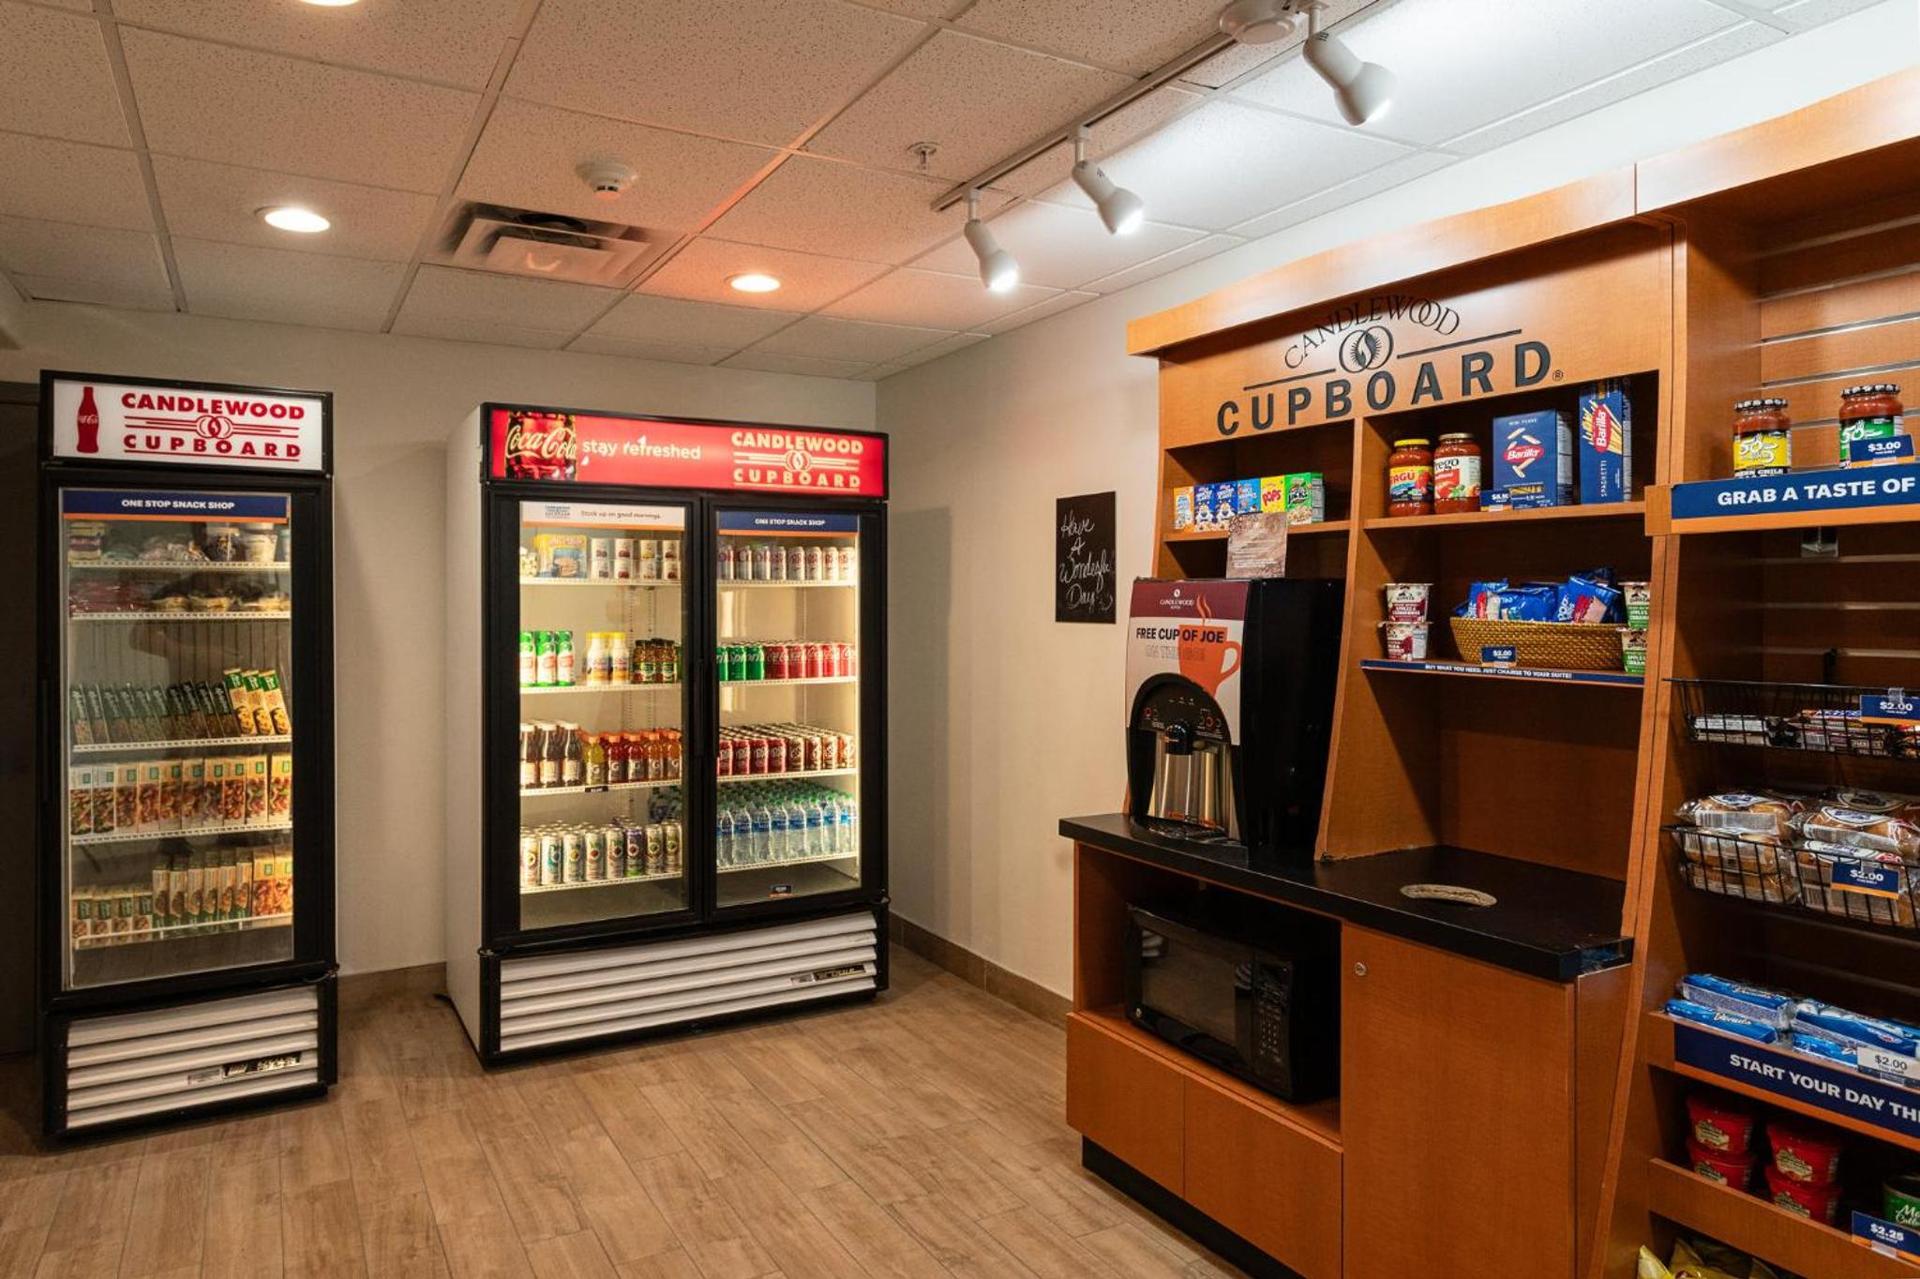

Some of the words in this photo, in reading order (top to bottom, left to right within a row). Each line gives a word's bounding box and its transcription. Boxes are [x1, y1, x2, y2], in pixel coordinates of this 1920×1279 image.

[1284, 294, 1461, 369] CANDLEWOOD
[121, 392, 305, 420] CANDLEWOOD
[1596, 411, 1607, 448] Barilla
[123, 434, 301, 458] CUPBOARD
[582, 440, 618, 457] stay
[623, 436, 701, 460] refreshed
[731, 431, 863, 454] CANDLEWOOD
[1867, 441, 1901, 453] $3.00
[1507, 447, 1541, 460] Barilla
[1434, 458, 1460, 470] rego
[733, 469, 861, 488] CUPBOARD
[1717, 489, 1777, 506] GRAB
[1782, 487, 1799, 501] A
[1804, 481, 1876, 499] TASTE
[1882, 477, 1916, 494] OF
[121, 499, 143, 508] ONE
[145, 499, 171, 508] STOP
[172, 500, 206, 509] SNACK
[208, 501, 235, 510] SHOP
[1136, 628, 1157, 640] FREE
[1158, 628, 1181, 641] CUP
[1182, 629, 1198, 642] OF
[1200, 629, 1225, 643] JOE
[1880, 701, 1913, 711] $2.00
[1849, 869, 1885, 882] $2.00
[1874, 1055, 1908, 1071] $2.00
[1730, 1053, 1785, 1081] START
[1789, 1071, 1841, 1098] YOUR
[1845, 1088, 1885, 1112] DAY
[1889, 1101, 1920, 1124] TH
[1870, 1222, 1905, 1242] $2.25
